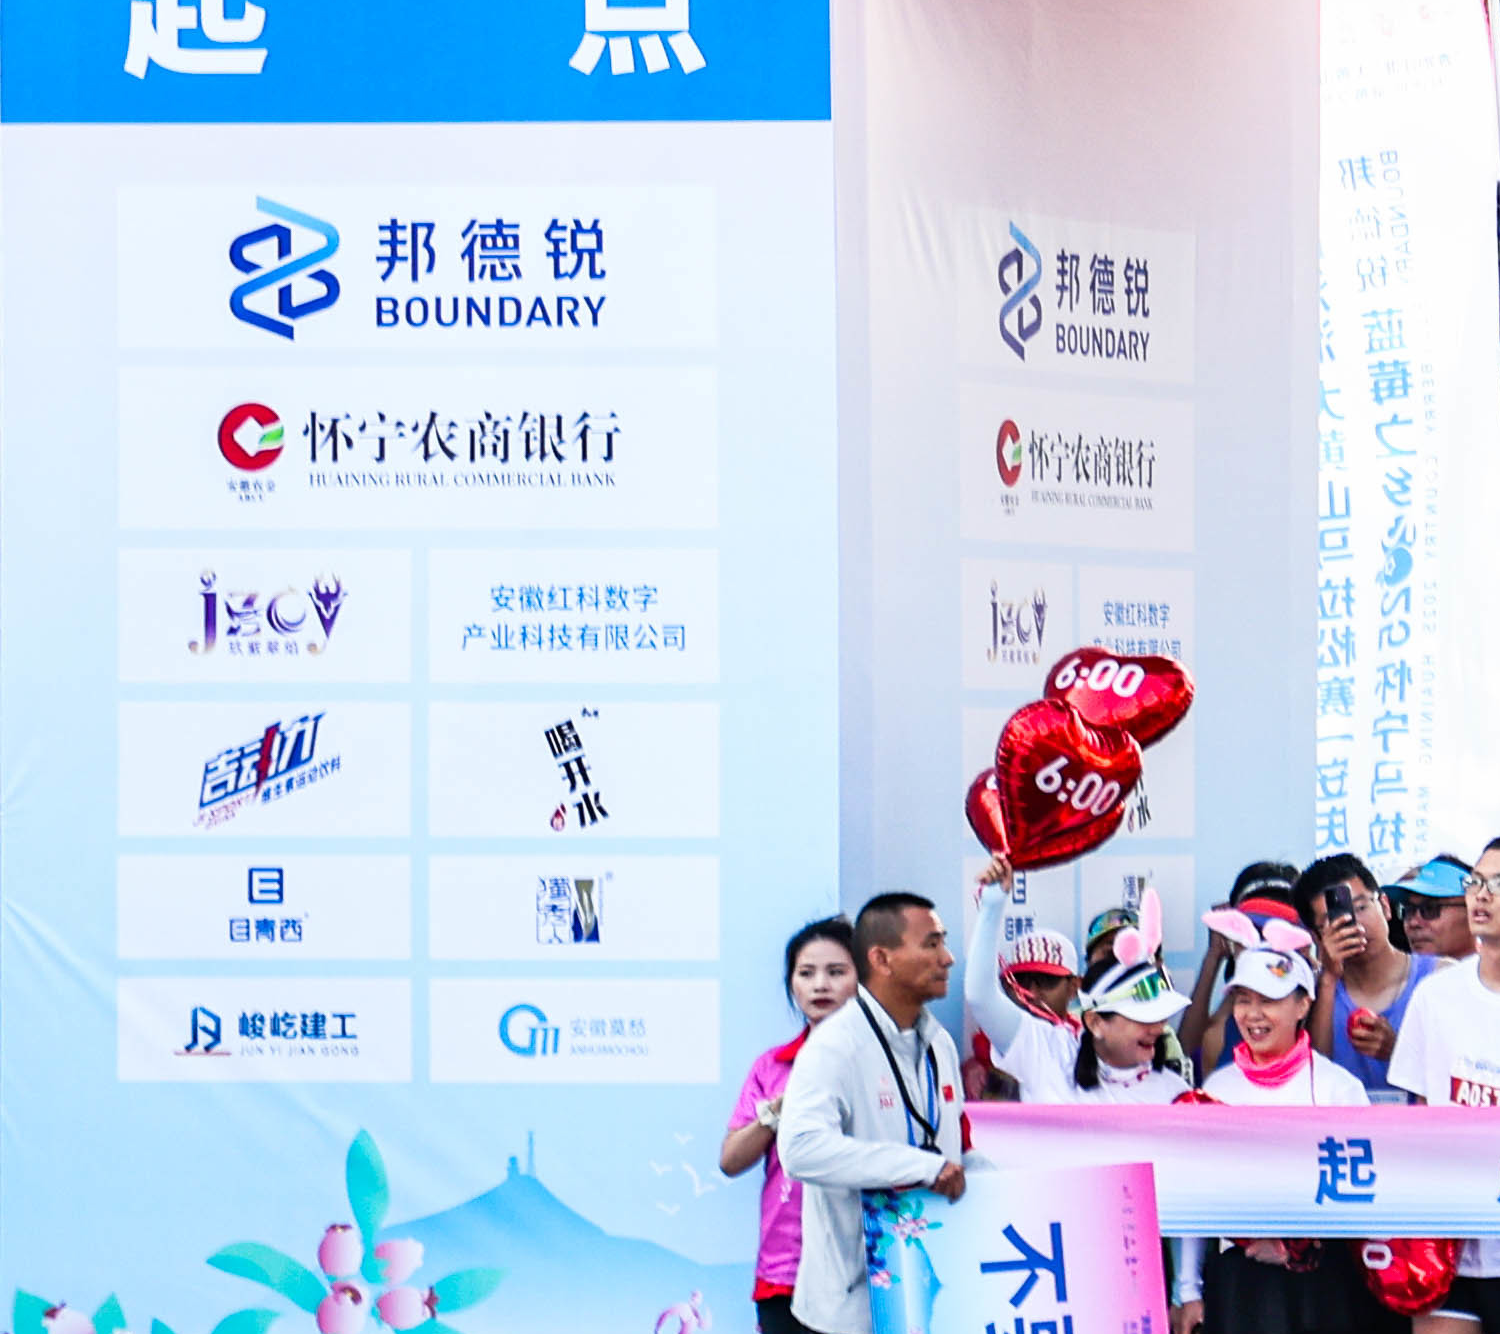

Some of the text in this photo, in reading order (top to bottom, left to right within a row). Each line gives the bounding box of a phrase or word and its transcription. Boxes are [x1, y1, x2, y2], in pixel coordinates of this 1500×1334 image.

[376, 218, 606, 283] 邦德锐
[1055, 249, 1149, 319] 邦德锐
[376, 296, 606, 328] BOUNDARY
[1056, 323, 1149, 362] BOUNDARY
[302, 410, 620, 464] 怀宁农商银行
[309, 472, 616, 487] HUAINING RURAL COMMERCIAL BANK
[1029, 430, 1155, 489] 怀宁农商银行
[491, 584, 658, 613] 安徽红科数字
[462, 623, 686, 652] 产业科技有限公司
[1055, 657, 1145, 698] 6:00
[545, 720, 608, 827] 喝开水
[1035, 755, 1120, 817] 6:00
[239, 1011, 357, 1041] 峻屹建工
